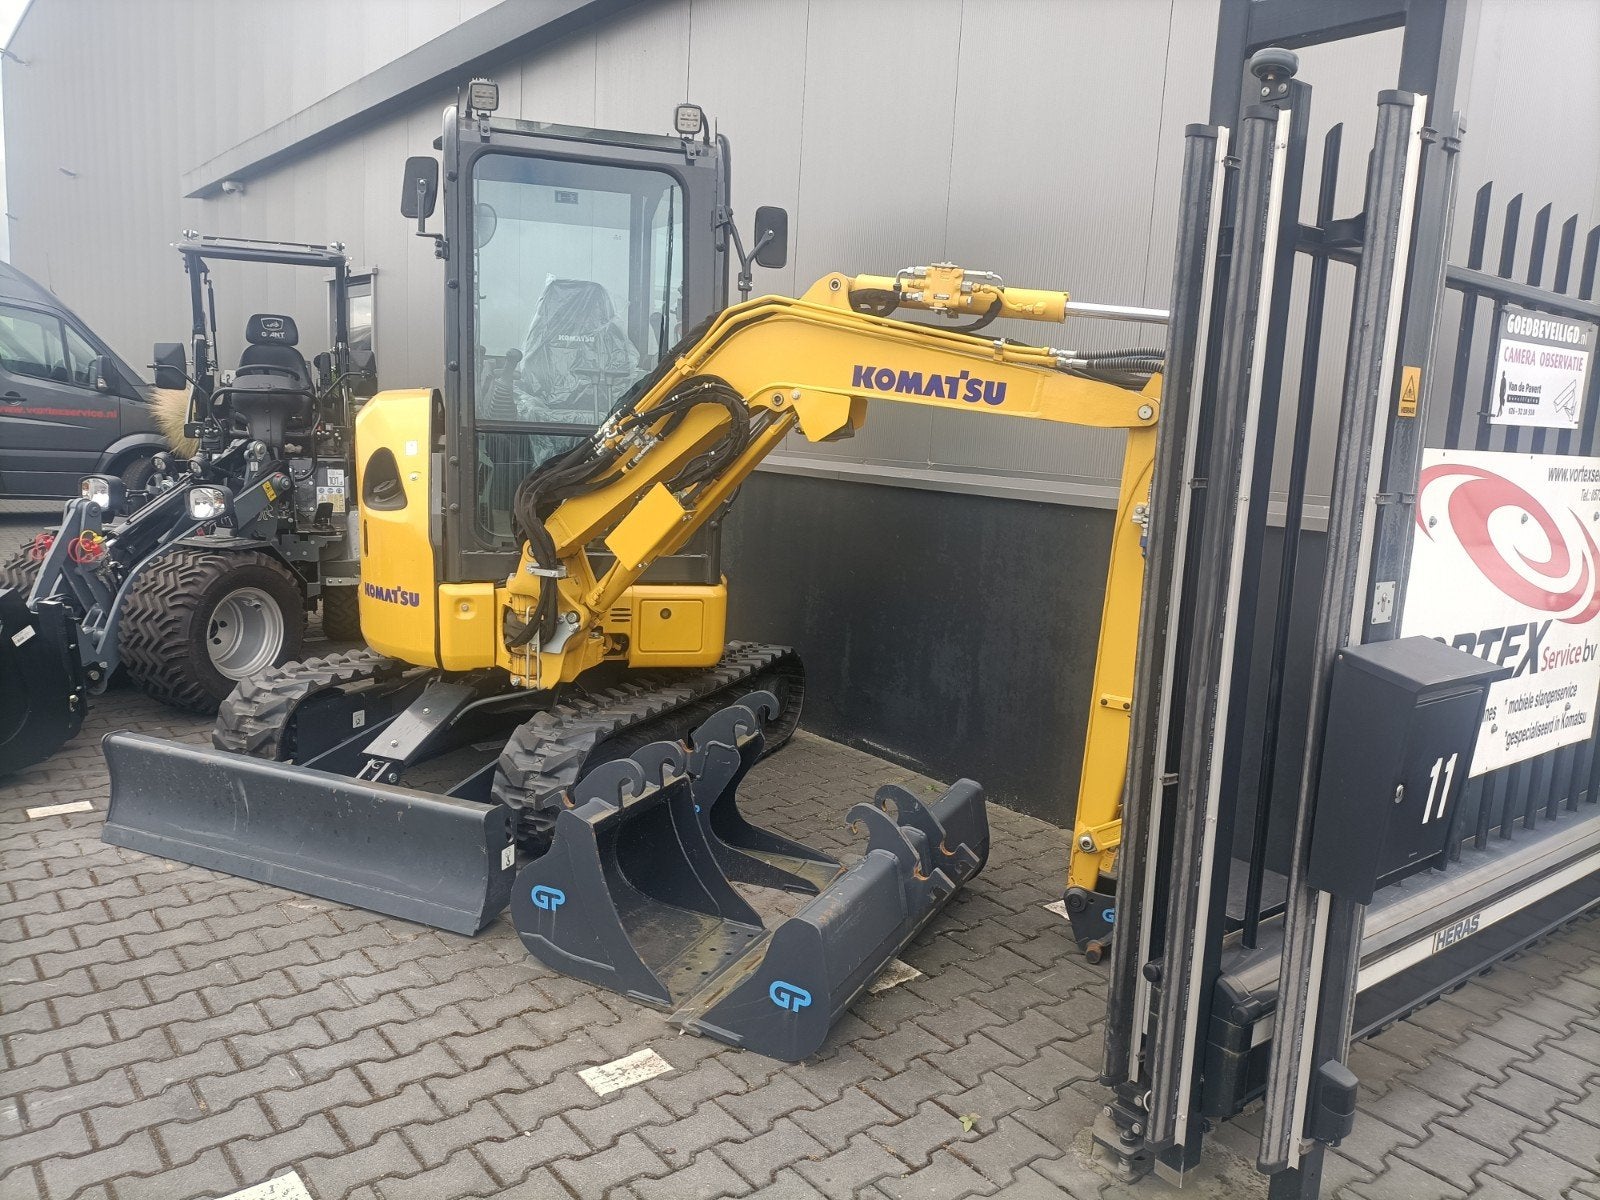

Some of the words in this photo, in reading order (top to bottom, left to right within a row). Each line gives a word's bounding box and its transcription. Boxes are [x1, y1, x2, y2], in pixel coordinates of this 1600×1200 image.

[1504, 346, 1536, 366] CAMERA
[1540, 351, 1583, 372] OBSERVATIE
[852, 365, 1007, 406] KOMATSU
[364, 582, 420, 607] KOMATSU
[1541, 643, 1582, 672] Service
[1582, 638, 1598, 663] bv
[1508, 692, 1534, 714] mobiele
[1534, 682, 1578, 708] slangenservice
[1560, 710, 1588, 729] Komatsu
[1422, 753, 1458, 824] 11
[531, 885, 565, 911] GP
[1436, 914, 1480, 950] HERAS
[770, 981, 811, 1012] GP
